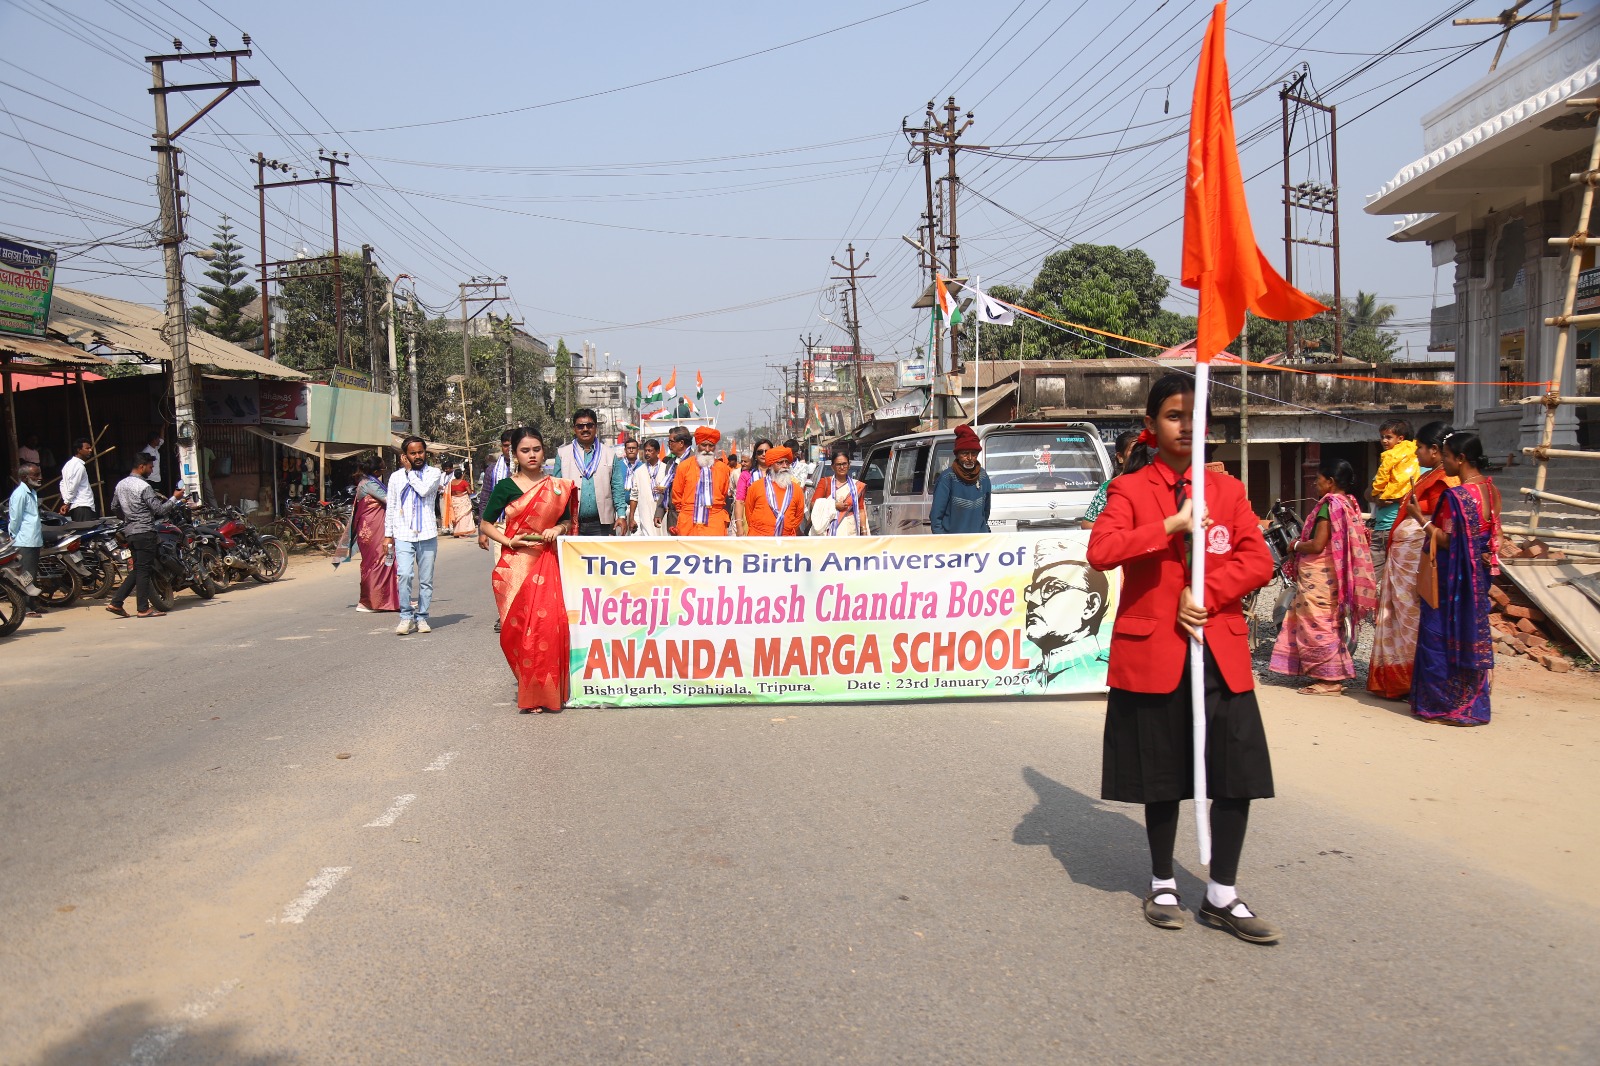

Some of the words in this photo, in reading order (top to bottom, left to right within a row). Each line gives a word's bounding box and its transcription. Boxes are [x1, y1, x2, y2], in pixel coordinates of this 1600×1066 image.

[580, 555, 637, 576] The
[649, 554, 732, 575] 129th
[742, 552, 812, 574] Birth
[820, 550, 990, 573] Anniversary
[998, 546, 1027, 567] of
[579, 587, 672, 636] Netaji
[678, 584, 806, 626] Subhash
[815, 581, 939, 623] Chandra
[946, 580, 1015, 619] Bose
[583, 638, 743, 680] ANANDA
[753, 634, 883, 678] MARGA
[891, 628, 1030, 673] SCHOOL
[583, 684, 667, 697] Bishalgarh,
[672, 683, 752, 697] Sipahijala,
[757, 682, 816, 695] Tripura.
[847, 679, 881, 690] Date
[895, 678, 929, 689] 23rd
[933, 676, 990, 689] January
[994, 675, 1030, 687] 2026
